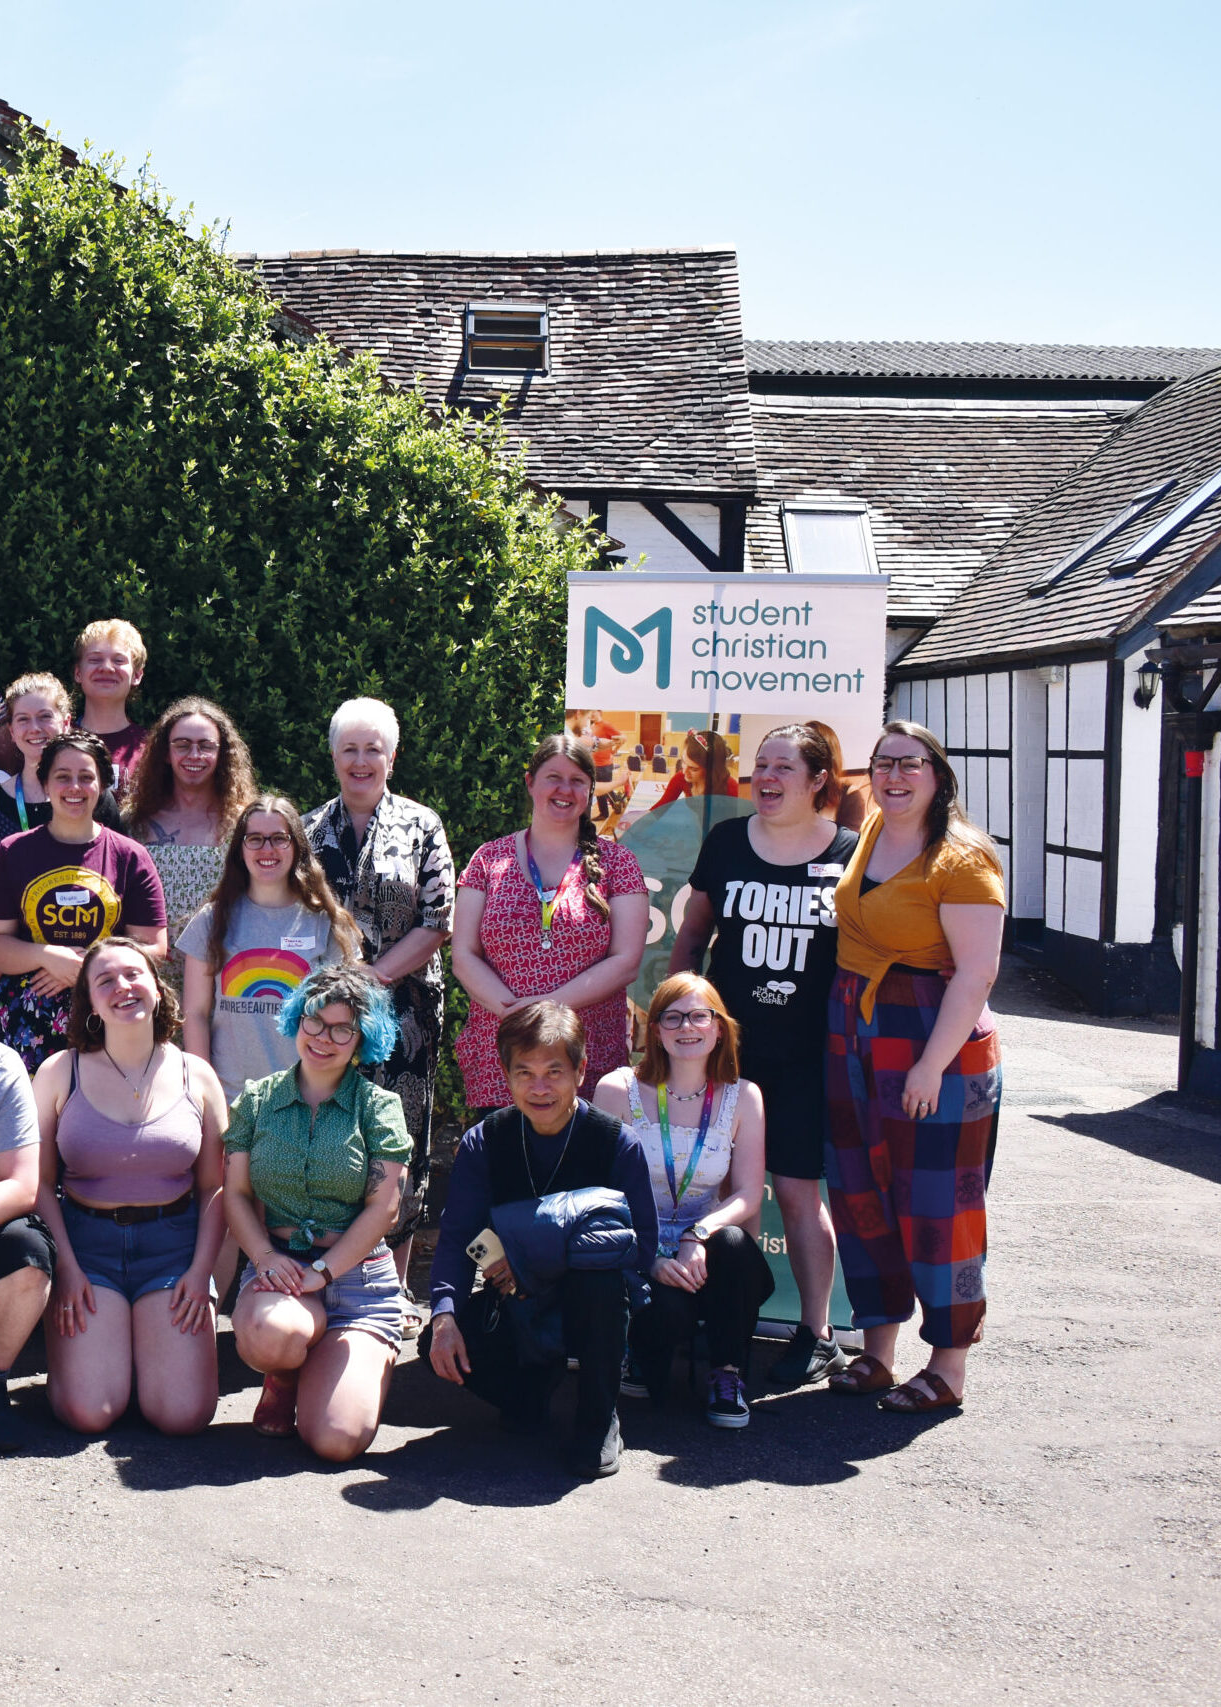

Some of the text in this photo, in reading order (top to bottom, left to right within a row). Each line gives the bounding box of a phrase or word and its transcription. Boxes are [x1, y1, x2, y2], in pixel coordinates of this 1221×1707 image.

[692, 599, 813, 626] student
[691, 631, 827, 660] christian
[691, 668, 865, 693] movement
[43, 904, 99, 928] SCM
[723, 880, 838, 928] TORIES
[742, 923, 815, 972] OUT
